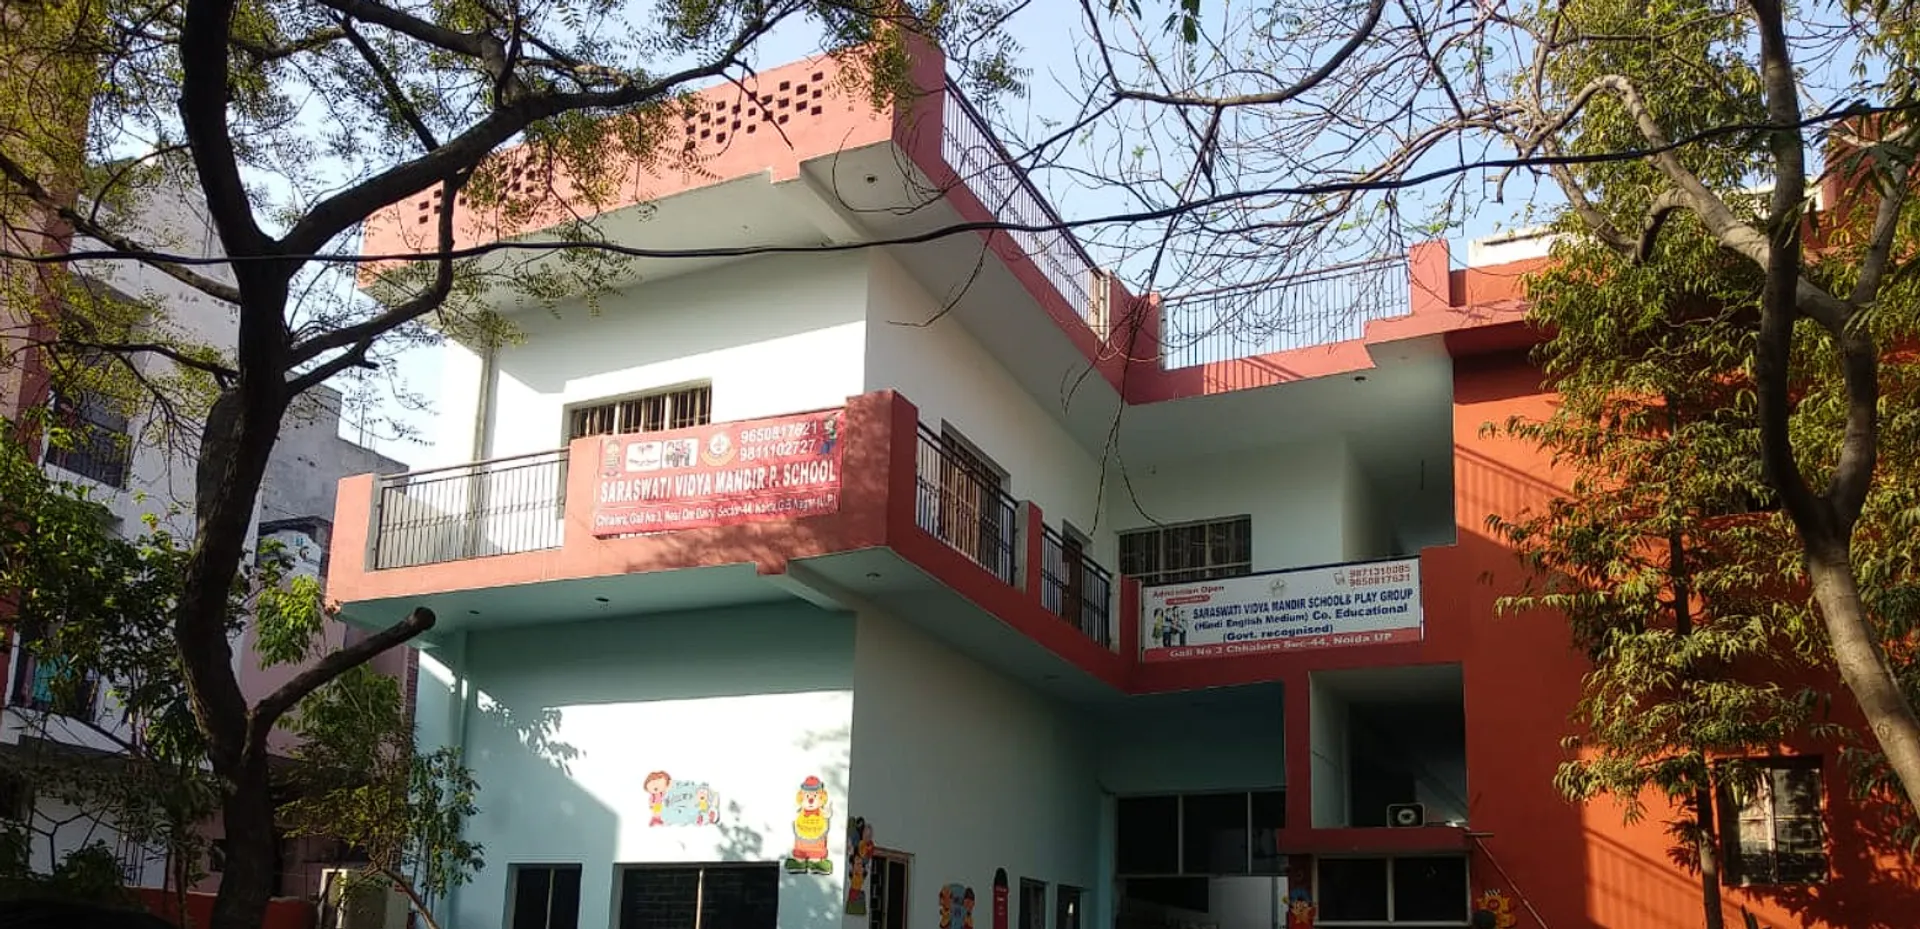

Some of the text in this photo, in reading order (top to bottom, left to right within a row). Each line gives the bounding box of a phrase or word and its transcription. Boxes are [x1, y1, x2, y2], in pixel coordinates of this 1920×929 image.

[741, 420, 817, 444] 9650817621
[740, 439, 816, 461] 9811102727
[600, 459, 836, 503] SARASWATI VIDYA MANDIR P. SCHOOL
[1201, 585, 1225, 594] Open
[1193, 605, 1241, 619] SARASWATI
[1243, 602, 1269, 615] VIDYA
[1271, 598, 1306, 612] MANDIR
[1354, 592, 1378, 604] PLAY
[1380, 588, 1413, 601] GROUP
[1194, 602, 1408, 631] (Hindi English Medium) Co. Educational
[1169, 648, 1193, 657] Gali
[1196, 647, 1212, 656] No
[1226, 642, 1280, 654] Chhalera
[1333, 635, 1370, 645] Noida
[1374, 633, 1393, 641] UP
[1223, 624, 1334, 643] (Govt. recognised)
